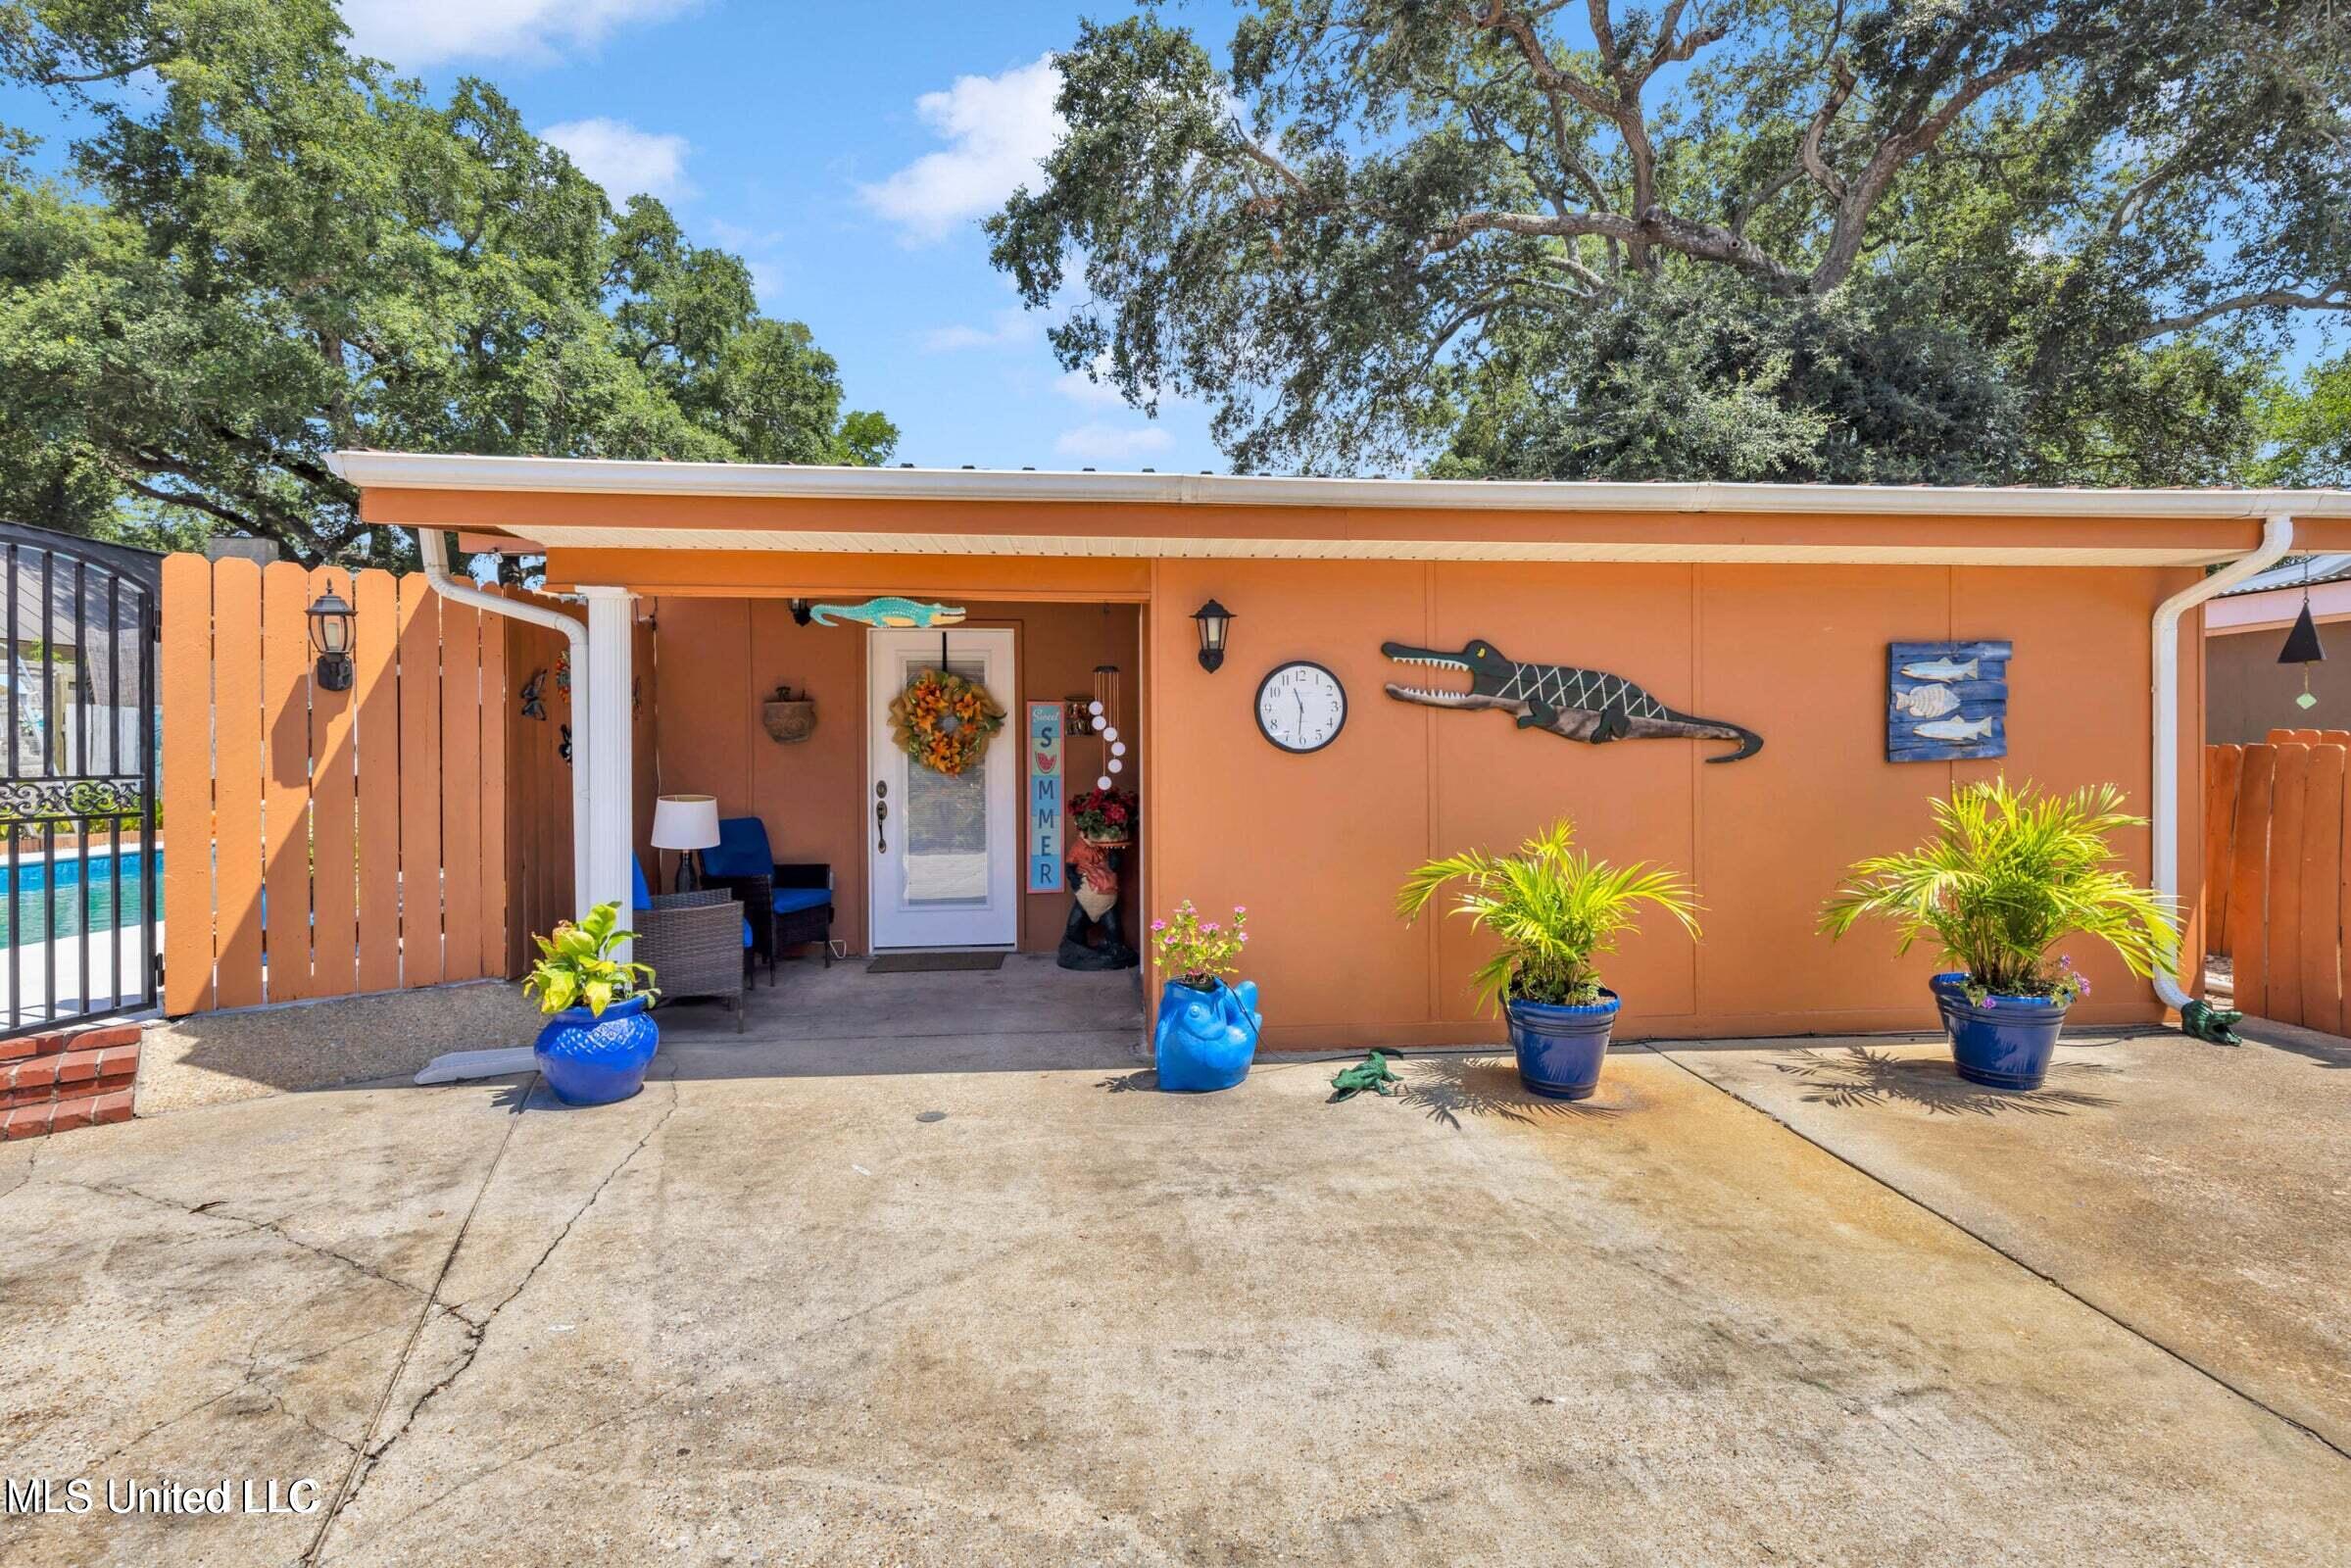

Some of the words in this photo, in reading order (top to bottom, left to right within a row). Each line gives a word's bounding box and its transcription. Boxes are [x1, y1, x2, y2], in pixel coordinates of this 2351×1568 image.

[1282, 673, 1290, 686] 11
[1296, 669, 1306, 682] 12
[1315, 673, 1319, 685] 1
[1270, 686, 1281, 699] 10
[1326, 684, 1334, 697] 2
[1264, 704, 1272, 713] 9
[1331, 701, 1339, 712] 3
[1033, 709, 1059, 723] Sweet
[1326, 716, 1334, 729] 4
[1270, 718, 1278, 730] 8
[1283, 730, 1291, 743] 7
[1298, 735, 1307, 746] 6
[1314, 729, 1323, 741] 5
